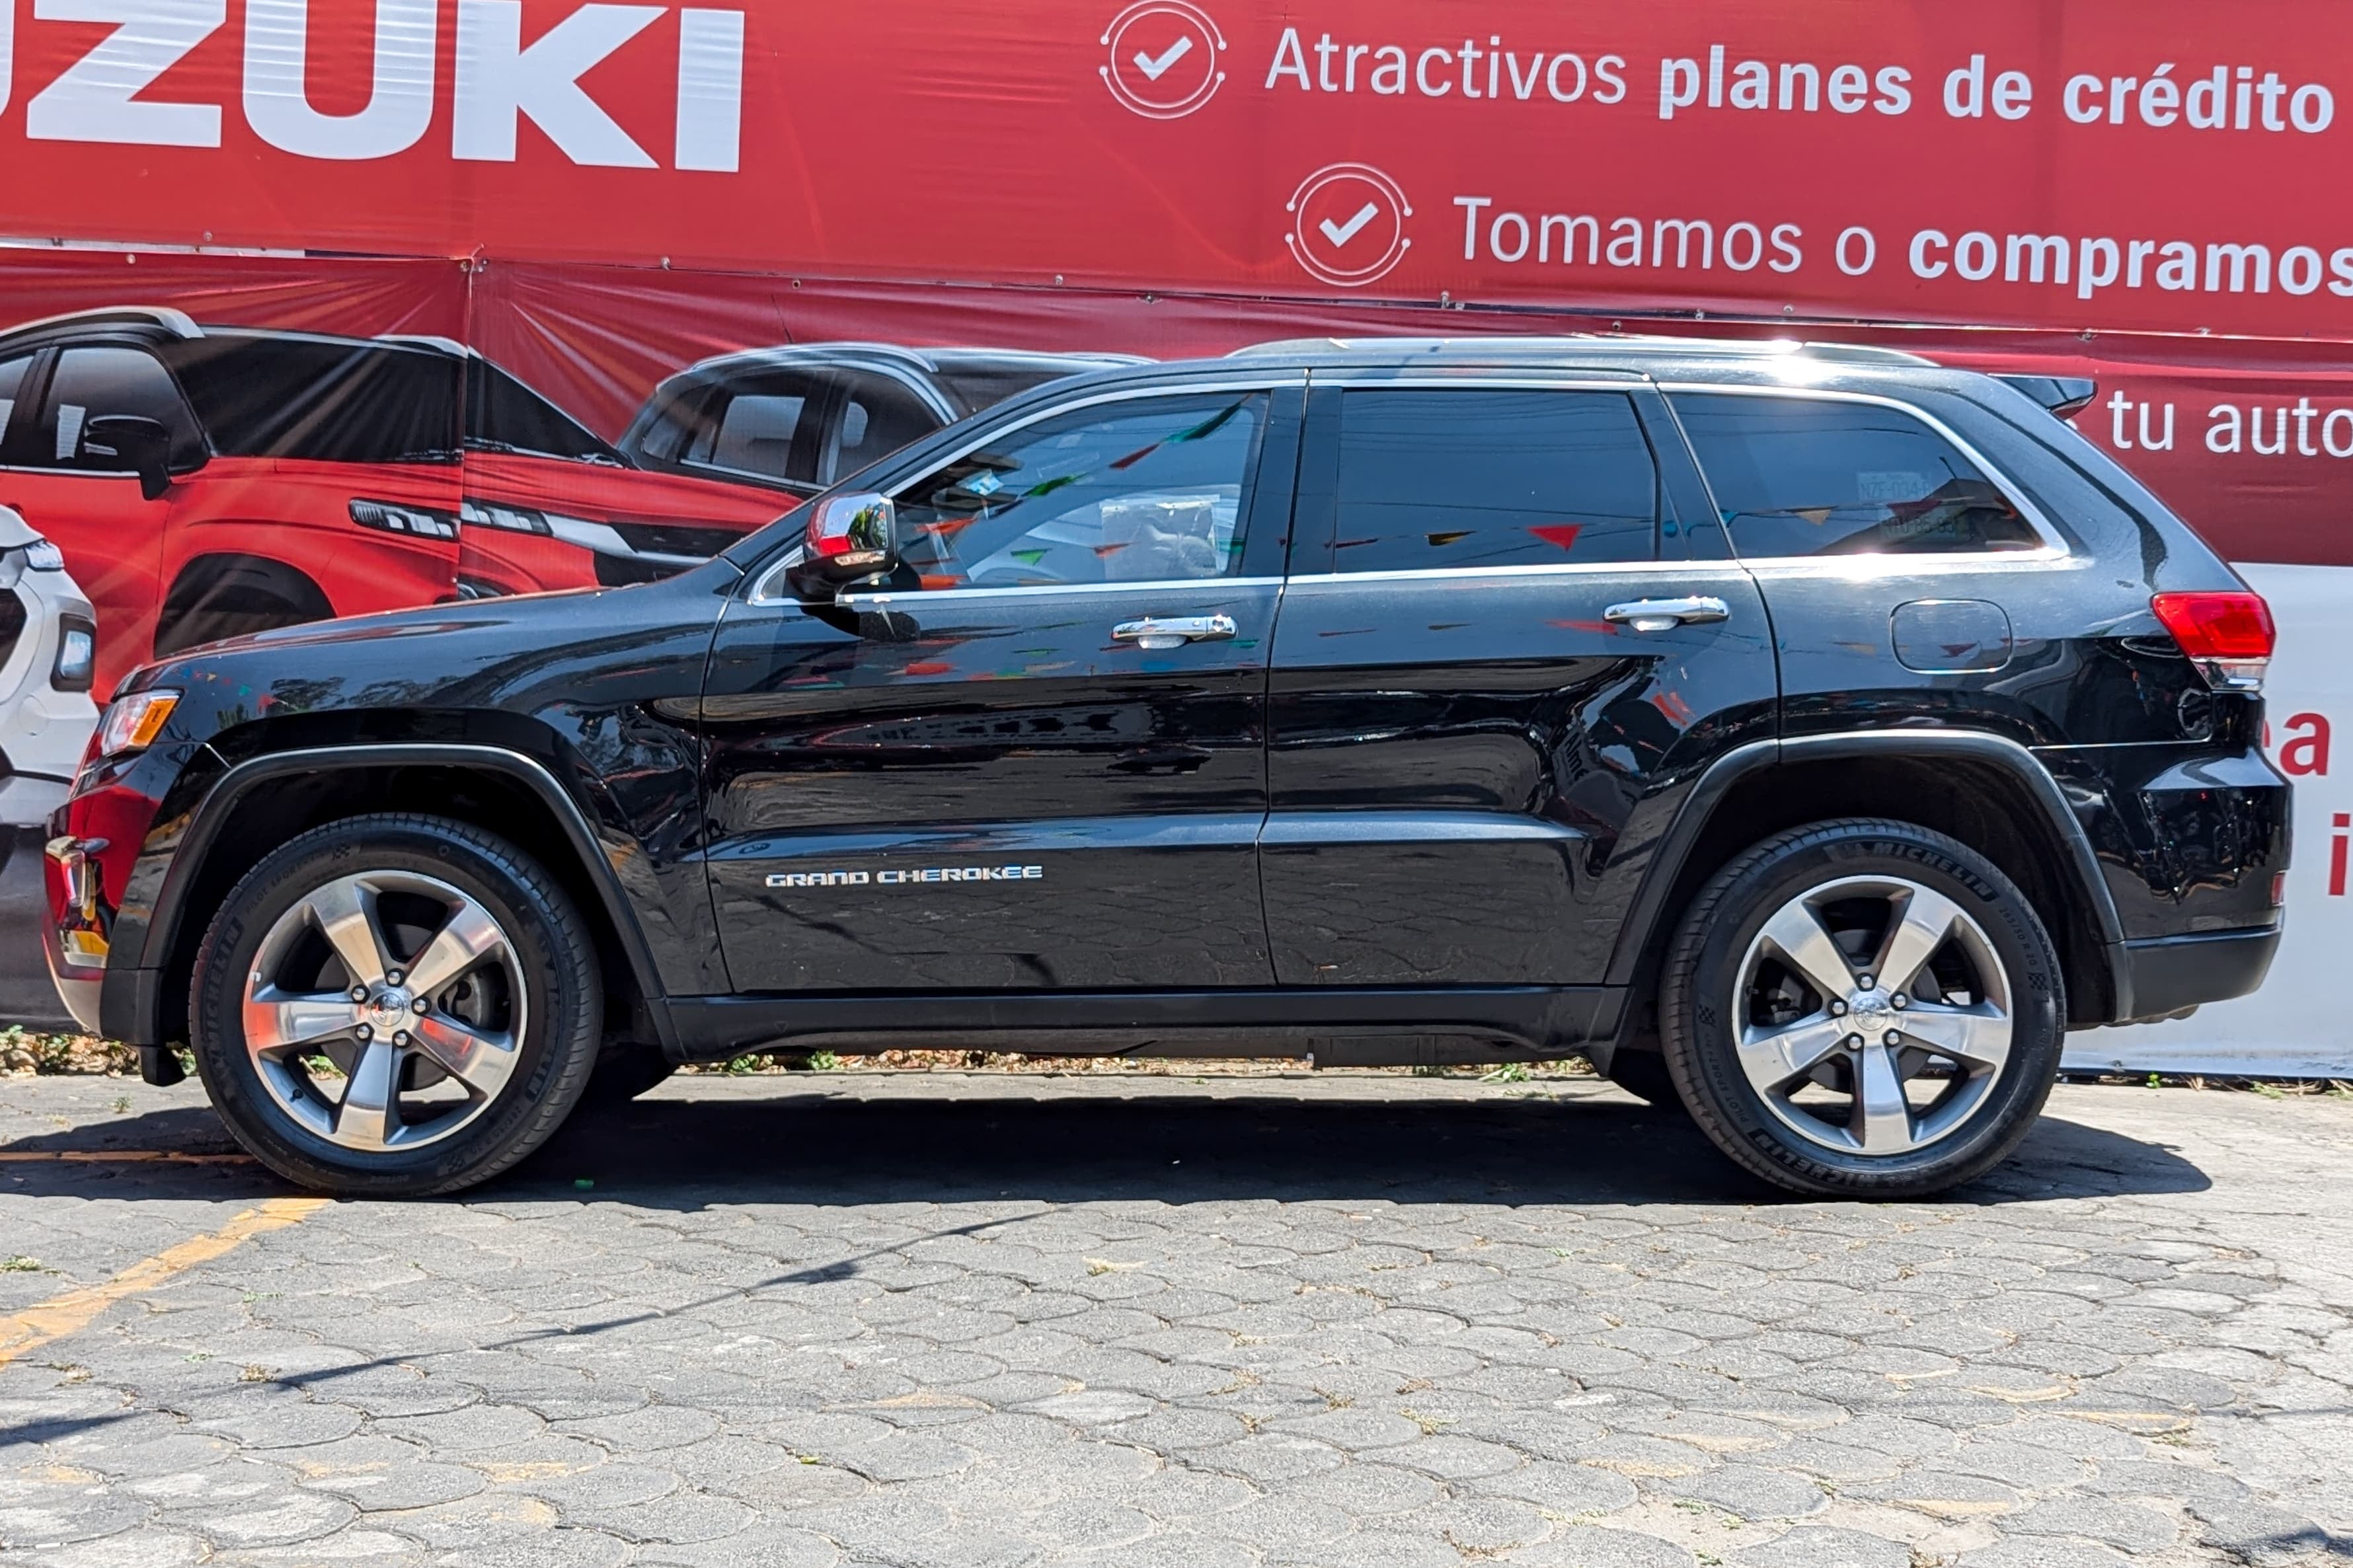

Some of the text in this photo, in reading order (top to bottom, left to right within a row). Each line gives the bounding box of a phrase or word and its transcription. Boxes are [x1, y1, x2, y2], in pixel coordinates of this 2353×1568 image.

[0, 0, 745, 172] ZUKI
[1265, 27, 2334, 133] Atractivos planes de crédito
[1453, 197, 2353, 299] Tomamos o compramos
[2107, 391, 2353, 457] tu auto
[765, 866, 1043, 887] GRAND CHEROKEE
[1872, 842, 1992, 897] MICHELIN
